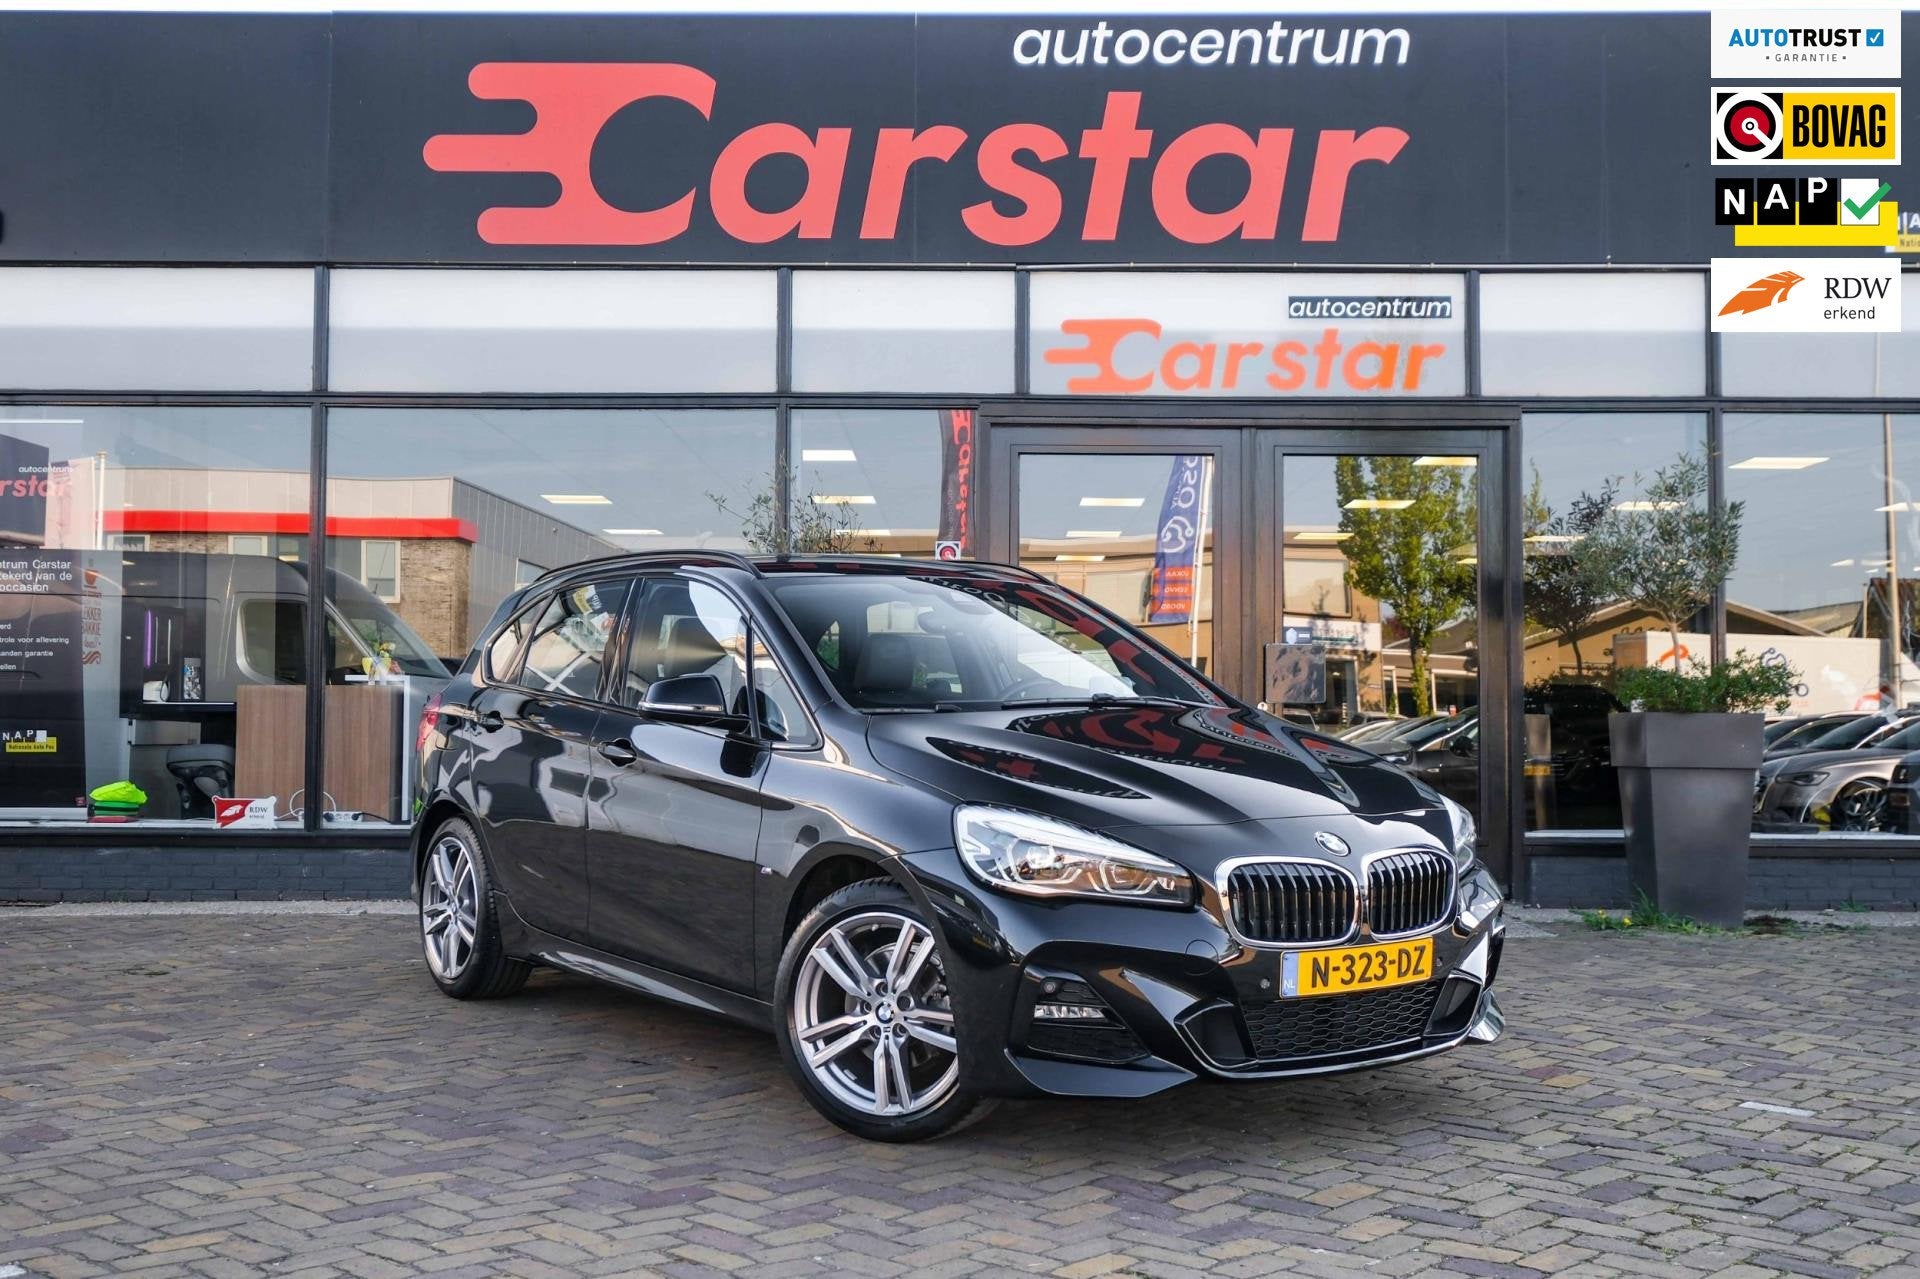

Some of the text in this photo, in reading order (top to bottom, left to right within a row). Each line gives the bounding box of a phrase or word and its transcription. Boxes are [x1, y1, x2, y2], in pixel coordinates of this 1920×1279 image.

[1012, 21, 1411, 66] autocentrum
[423, 62, 1411, 246] Carstar
[1289, 297, 1451, 318] autocentrum
[1043, 318, 1447, 394] Carstar
[0, 559, 72, 569] trum Carstar
[36, 573, 56, 581] van
[59, 571, 73, 581] de
[35, 636, 70, 645] aflevering
[24, 650, 54, 658] garantie
[1283, 945, 1427, 989] NL N-323-DZ
